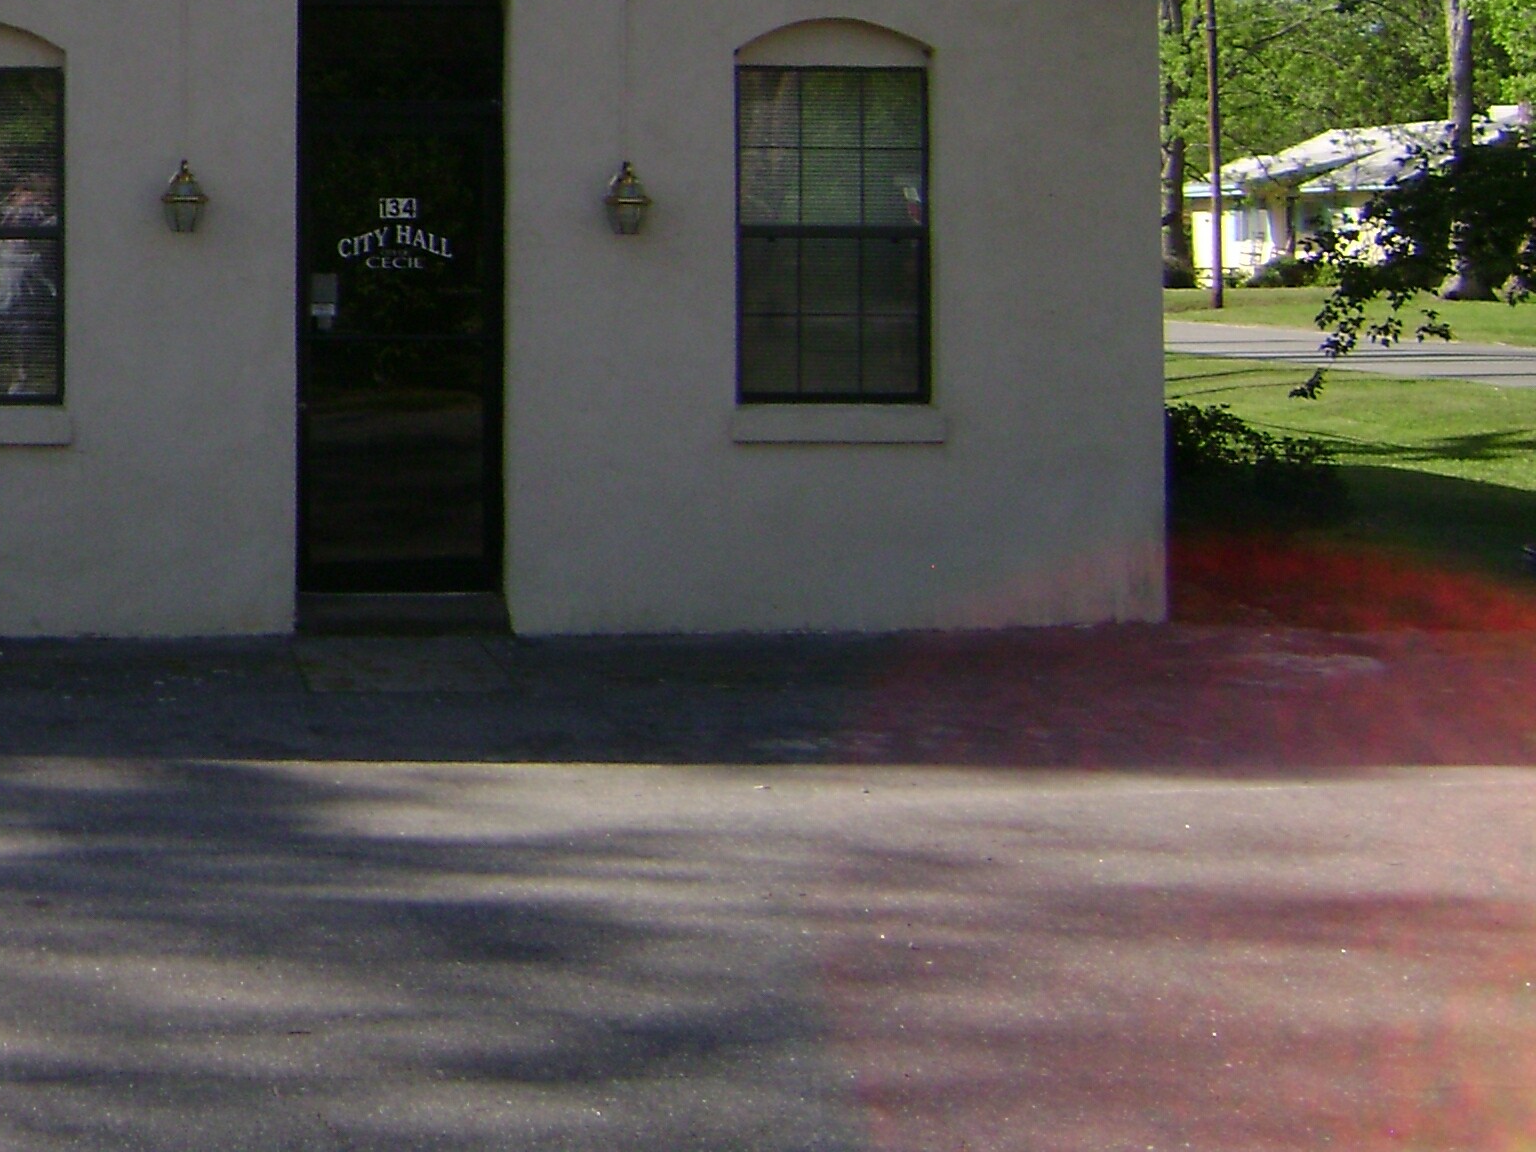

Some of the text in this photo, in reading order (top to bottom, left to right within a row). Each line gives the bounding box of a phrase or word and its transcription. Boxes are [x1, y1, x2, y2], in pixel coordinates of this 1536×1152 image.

[380, 198, 415, 218] 134
[337, 224, 453, 258] CITY HALL
[365, 256, 424, 269] CECIL
